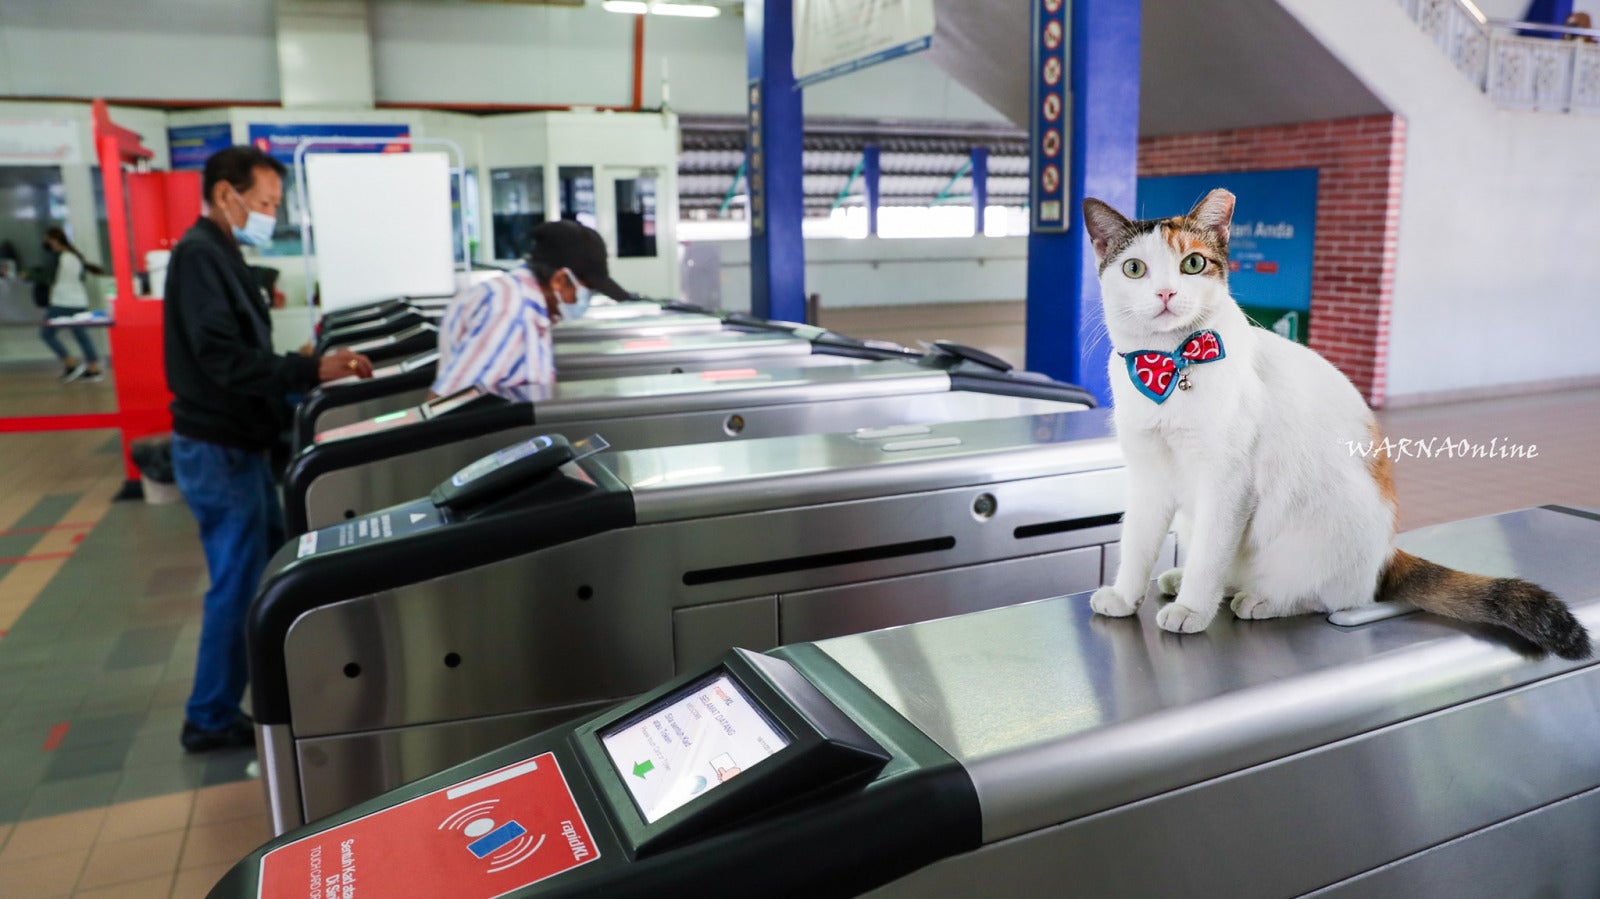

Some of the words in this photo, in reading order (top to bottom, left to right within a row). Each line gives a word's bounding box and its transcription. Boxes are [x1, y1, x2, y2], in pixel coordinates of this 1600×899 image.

[1254, 221, 1294, 239] Anda
[699, 694, 721, 716] SELAMAT
[715, 714, 736, 736] DATANG
[560, 820, 589, 861] rapidKL
[310, 845, 322, 871] TOUCH
[341, 838, 356, 868] Sentuh
[310, 869, 322, 890] CARD
[326, 873, 340, 887] Di
[342, 865, 357, 886] Kad
